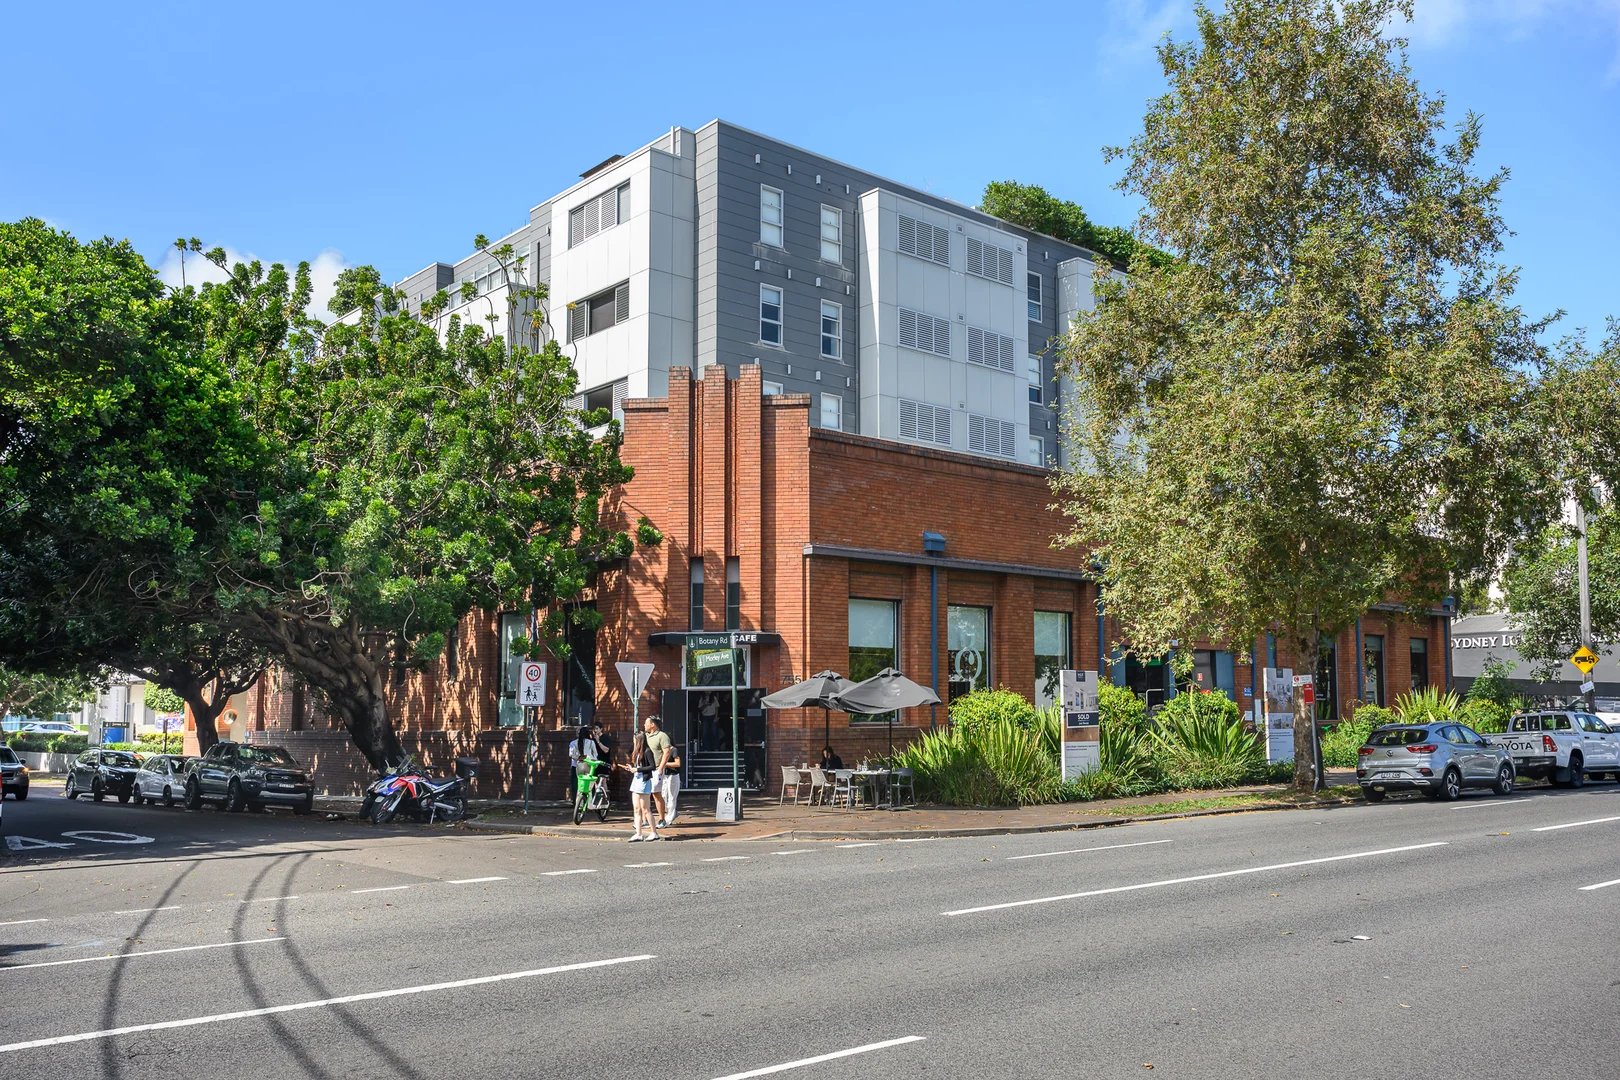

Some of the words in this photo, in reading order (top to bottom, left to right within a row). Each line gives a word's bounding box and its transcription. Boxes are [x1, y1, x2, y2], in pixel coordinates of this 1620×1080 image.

[698, 637, 719, 645] Botany
[735, 634, 757, 642] CAFE
[528, 669, 539, 677] 40
[781, 675, 802, 684] 755
[1497, 742, 1533, 751] OYOTA
[5, 830, 155, 850] 40
